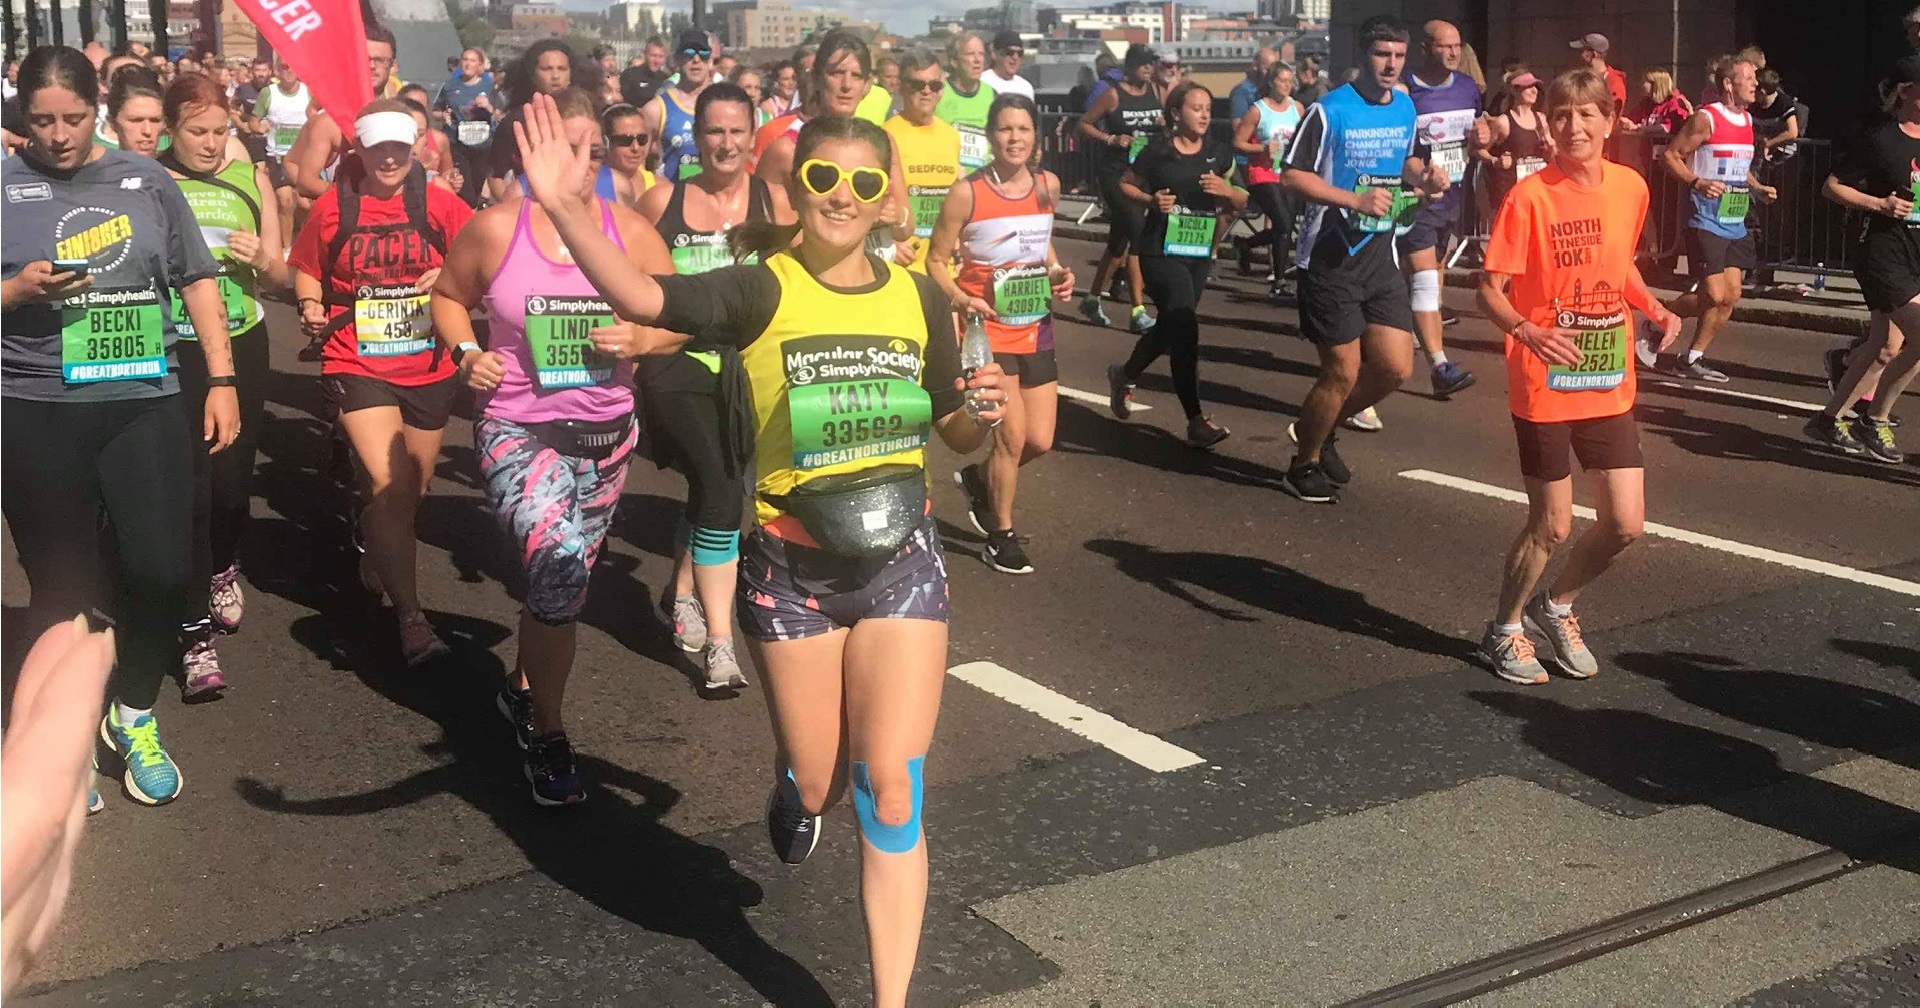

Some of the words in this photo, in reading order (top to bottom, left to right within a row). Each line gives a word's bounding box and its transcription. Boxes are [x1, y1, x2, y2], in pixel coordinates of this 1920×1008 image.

[1344, 159, 1364, 168] JON
[1444, 149, 1460, 161] PAUL
[908, 164, 955, 174] BEDFORD
[1178, 217, 1208, 230] NICOLA
[1550, 218, 1602, 238] NORTH
[1551, 233, 1603, 250] TYNESIDE
[1554, 248, 1584, 269] 10K
[1003, 279, 1044, 297] HARRIET
[549, 299, 612, 313] Simplyhea
[1006, 297, 1041, 314] 43097
[90, 309, 141, 333] BECKI
[87, 335, 145, 360] 35805
[1574, 331, 1616, 351] HELEN
[546, 343, 602, 366] 355
[867, 347, 921, 376] Society
[71, 360, 161, 380] #GREATNORTHRUN
[828, 382, 890, 415] KATY
[802, 434, 921, 467] #GREATNORTHRUN
